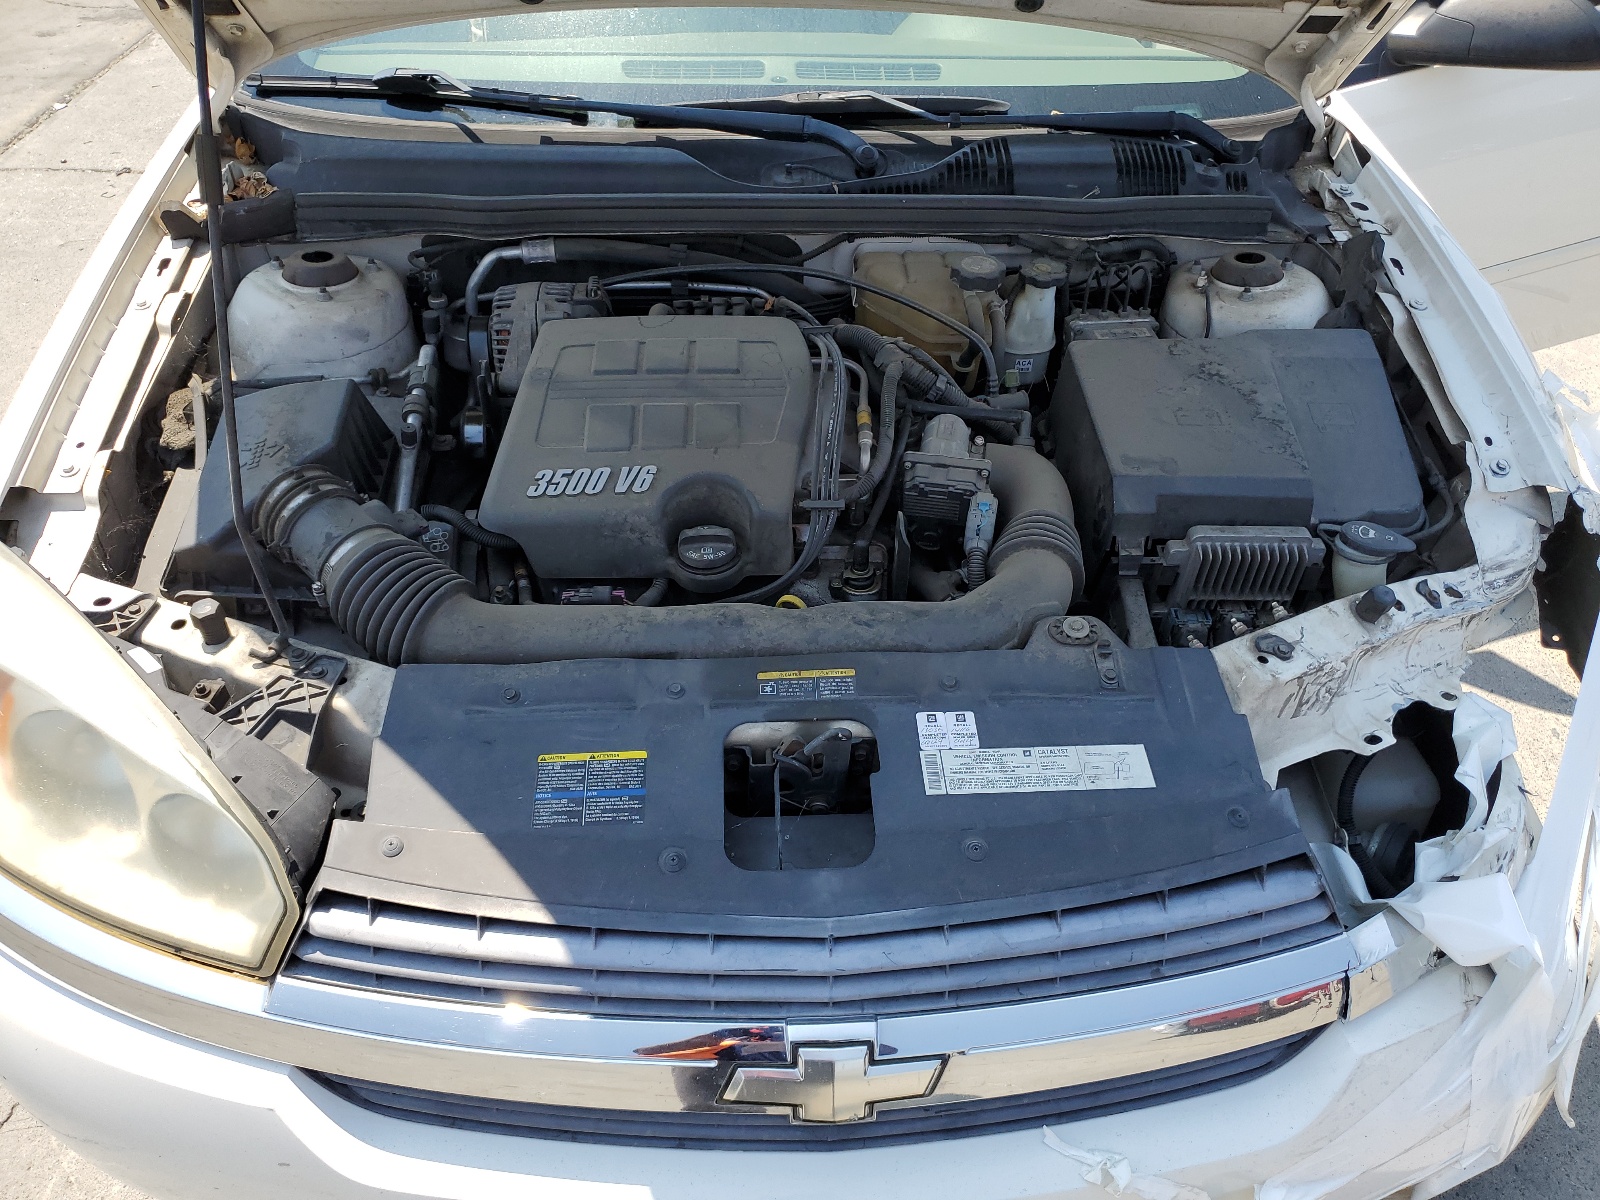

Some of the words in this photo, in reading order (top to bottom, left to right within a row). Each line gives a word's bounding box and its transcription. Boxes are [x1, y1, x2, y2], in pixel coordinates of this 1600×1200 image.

[526, 466, 611, 498] 3500
[614, 465, 658, 495] V6
[686, 550, 701, 559] SAE
[703, 550, 727, 560] 5W-30
